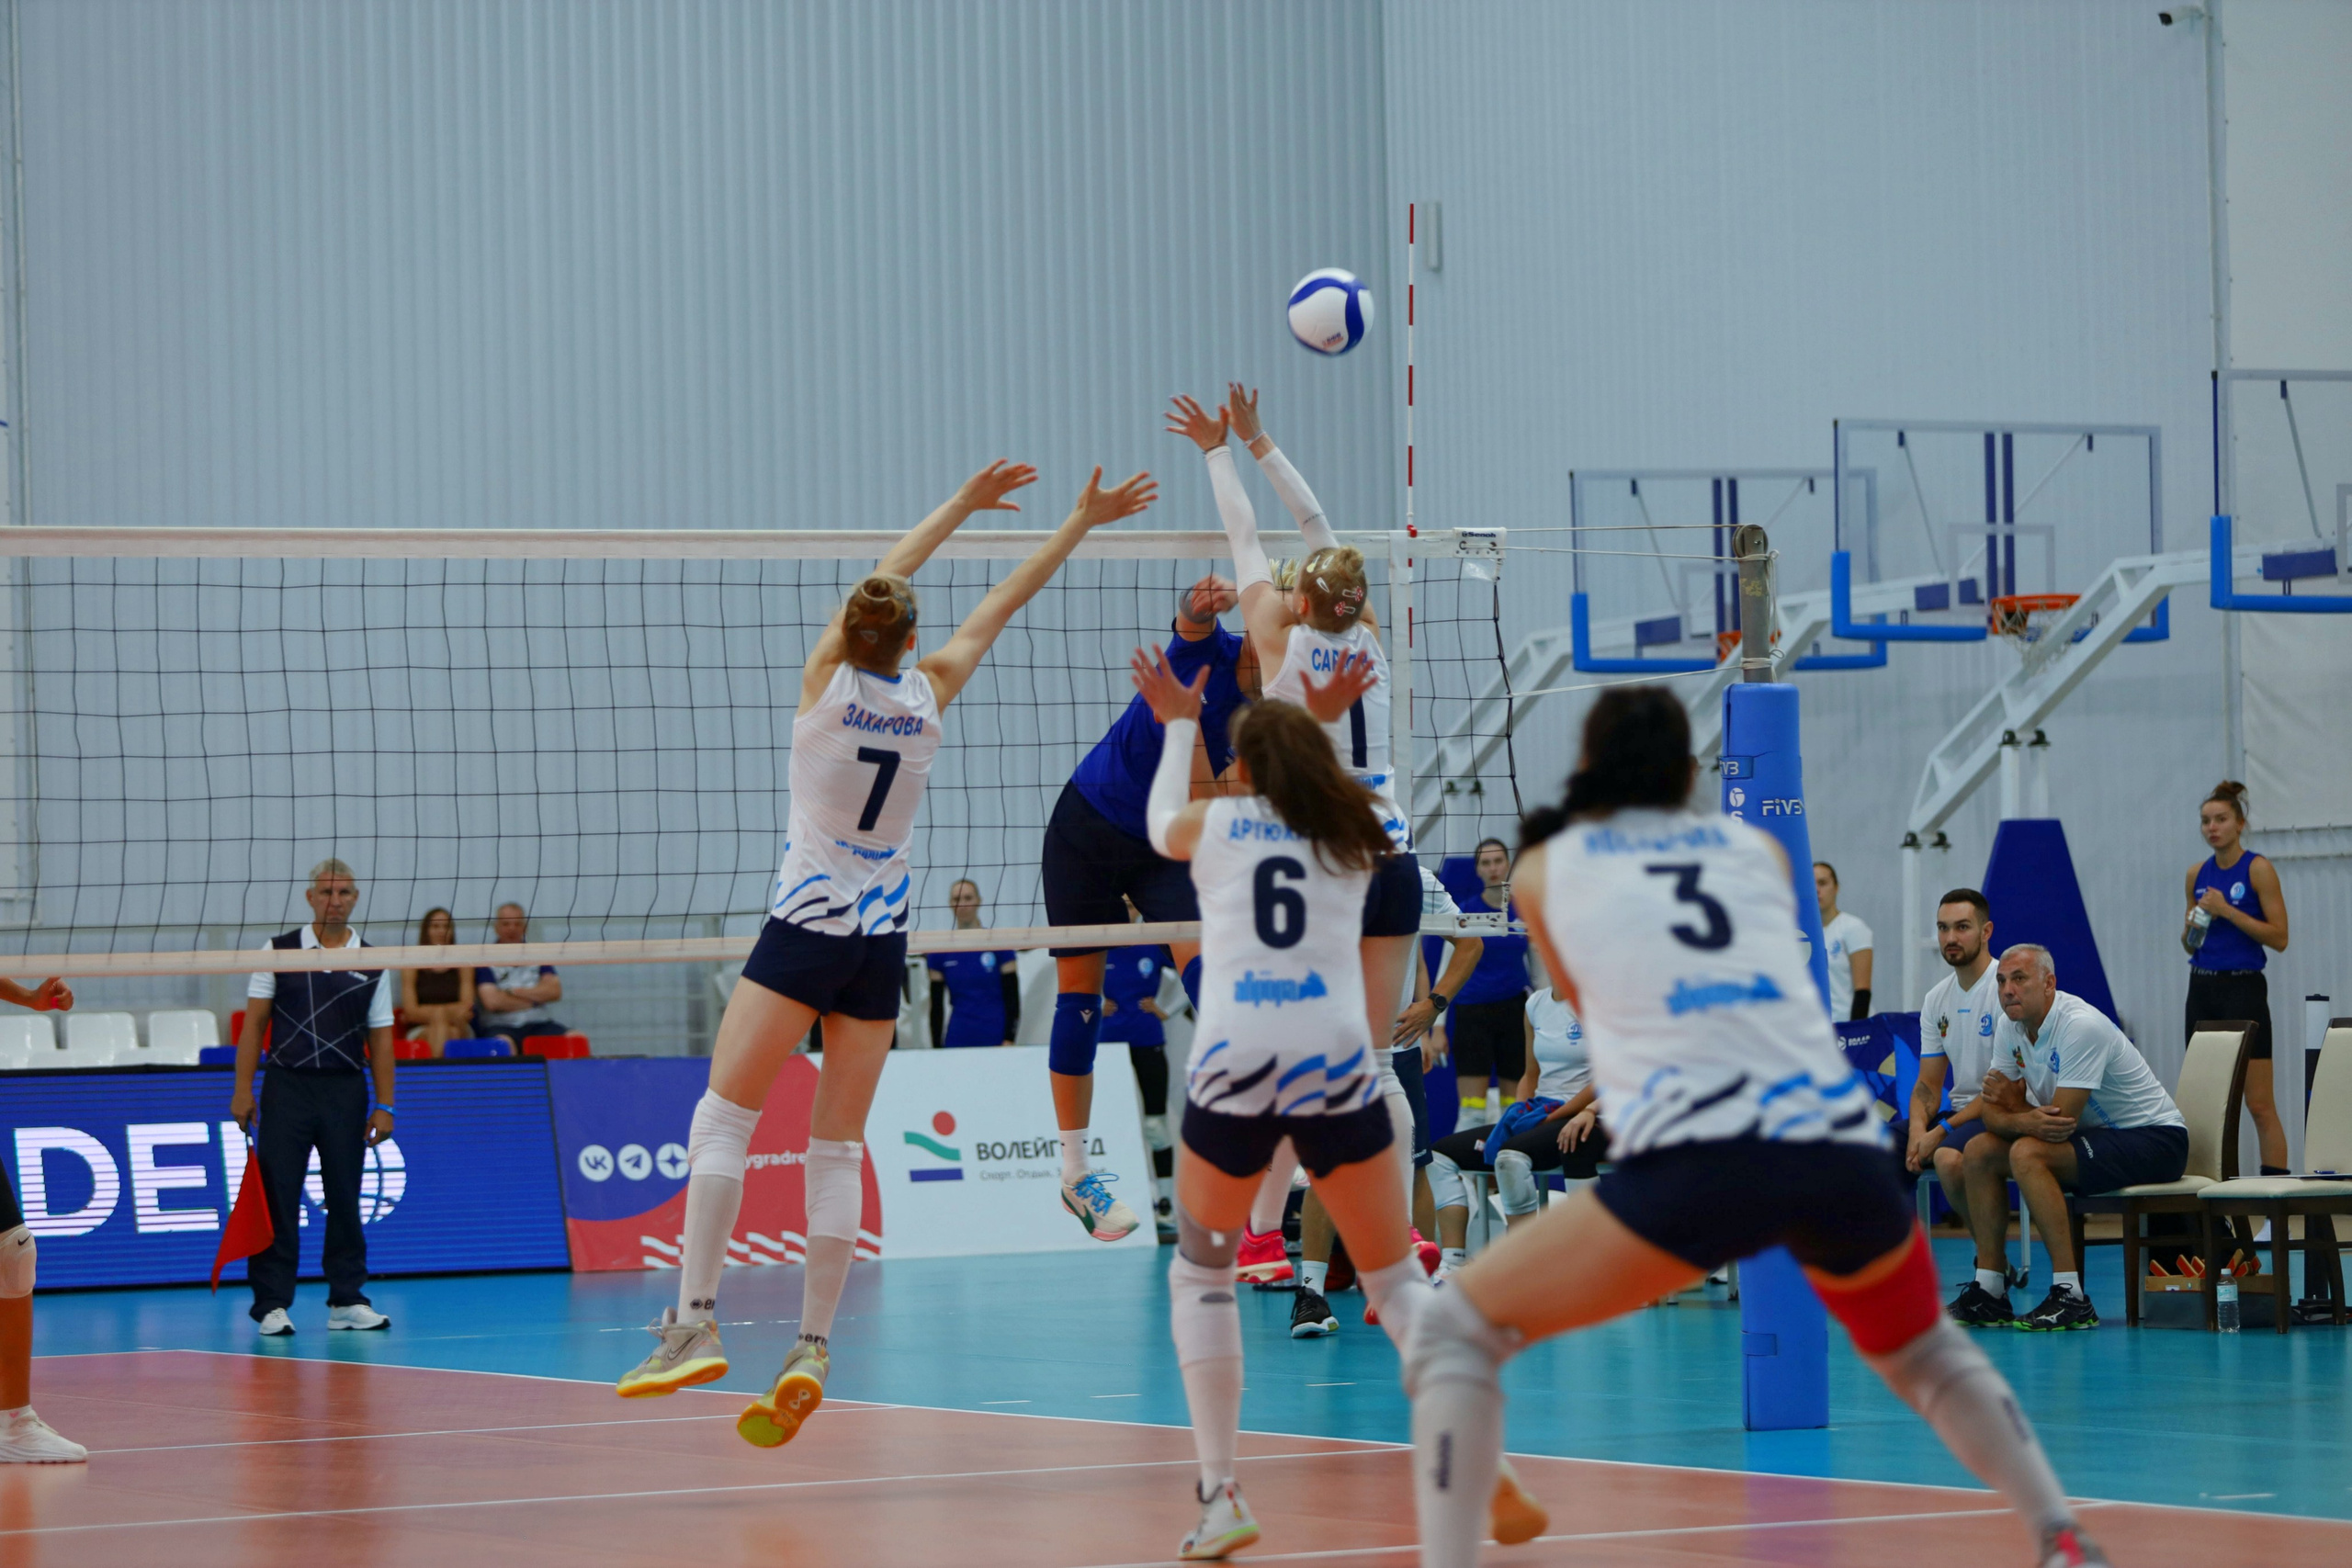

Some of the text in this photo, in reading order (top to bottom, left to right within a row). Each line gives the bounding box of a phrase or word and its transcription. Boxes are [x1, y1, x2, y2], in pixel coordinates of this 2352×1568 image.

[842, 703, 923, 736] ЗАХАРОВА
[857, 746, 900, 831] 7
[1253, 855, 1306, 950] 6
[1644, 863, 1733, 951] 3
[977, 1137, 1106, 1161] ВОЛЕЙГД
